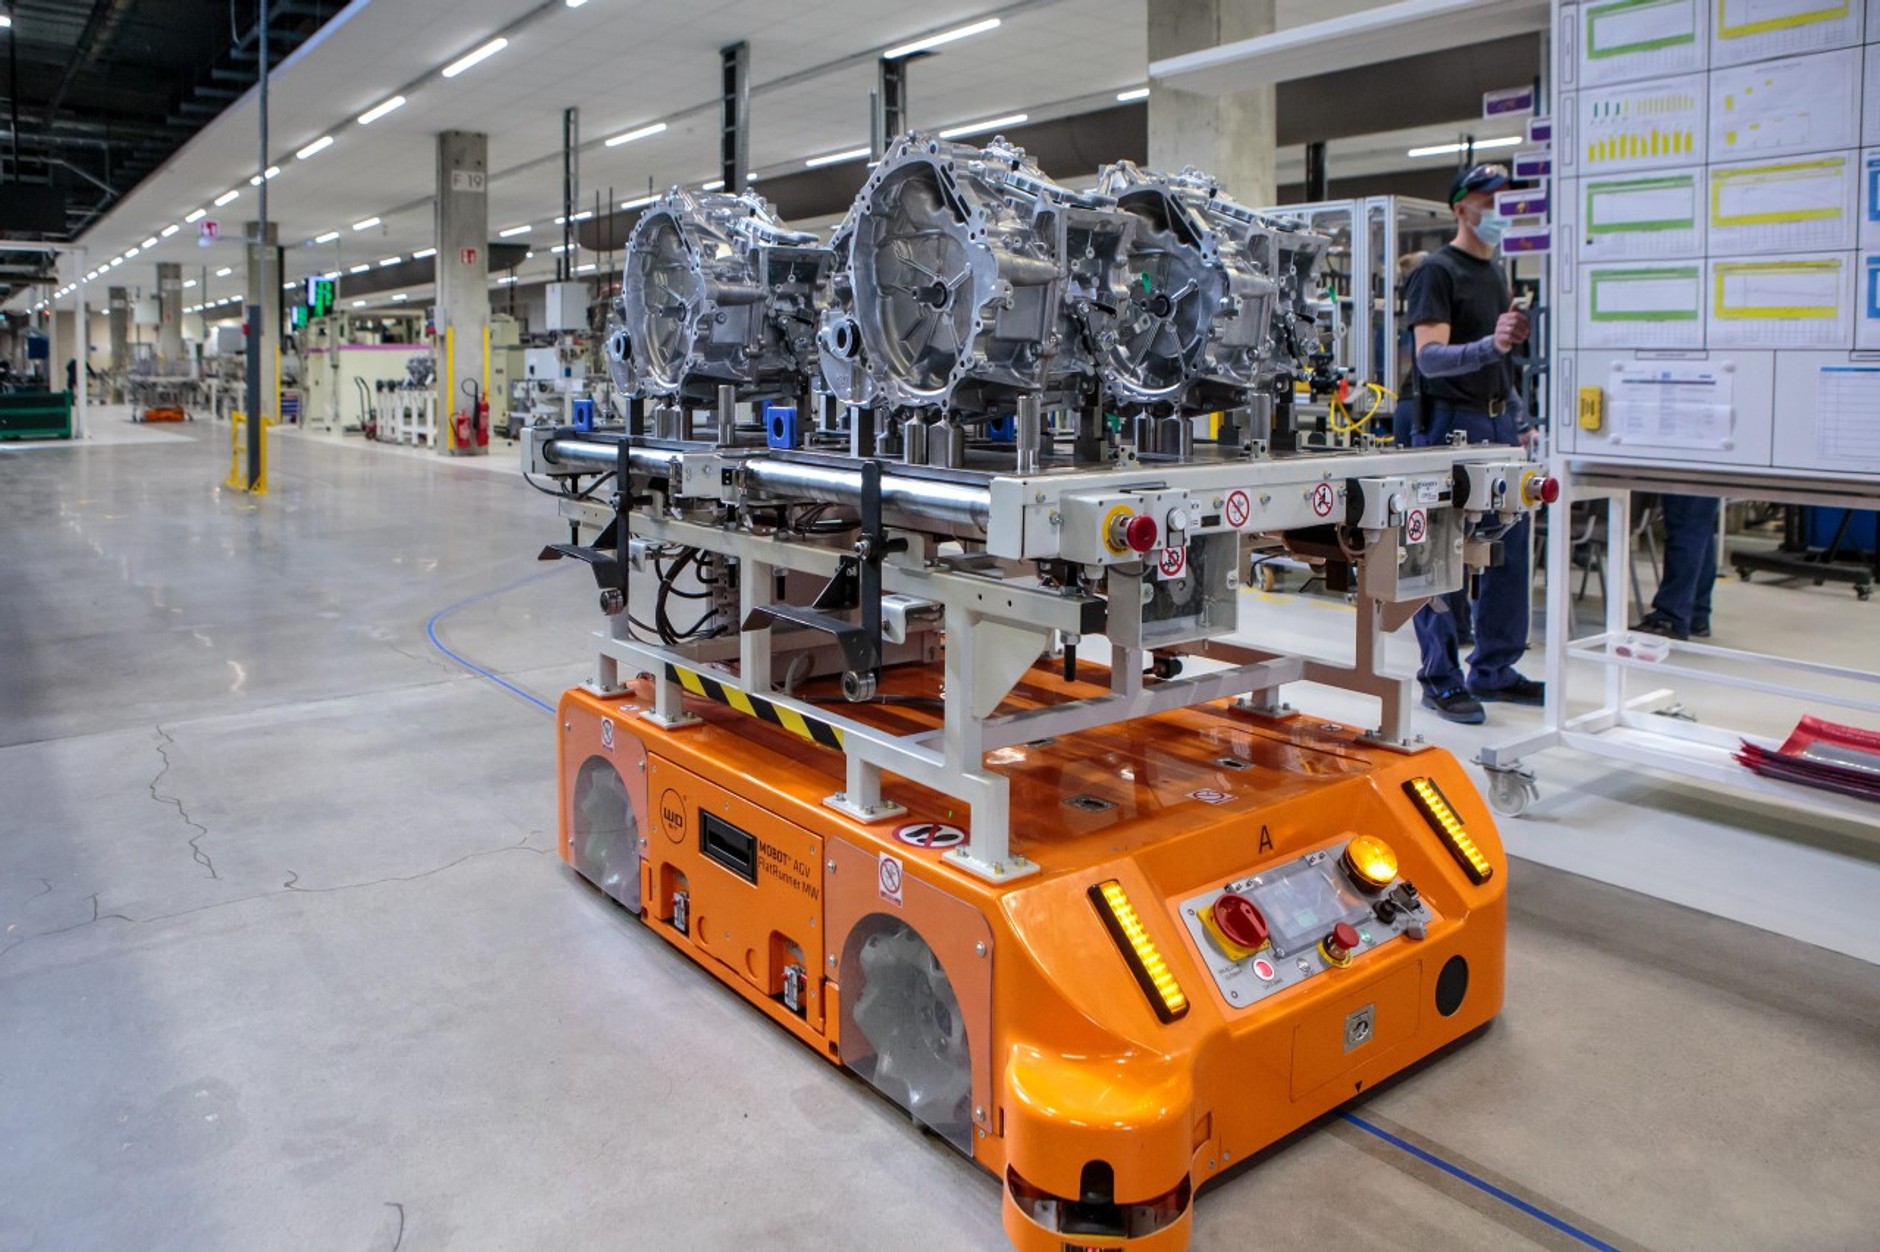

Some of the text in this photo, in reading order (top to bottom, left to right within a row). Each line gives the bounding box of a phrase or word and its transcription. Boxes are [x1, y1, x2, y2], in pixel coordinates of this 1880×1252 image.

[453, 173, 461, 188] F
[1259, 824, 1274, 855] A
[758, 856, 819, 901] FlatRunner MW
[793, 859, 811, 878] AGV
